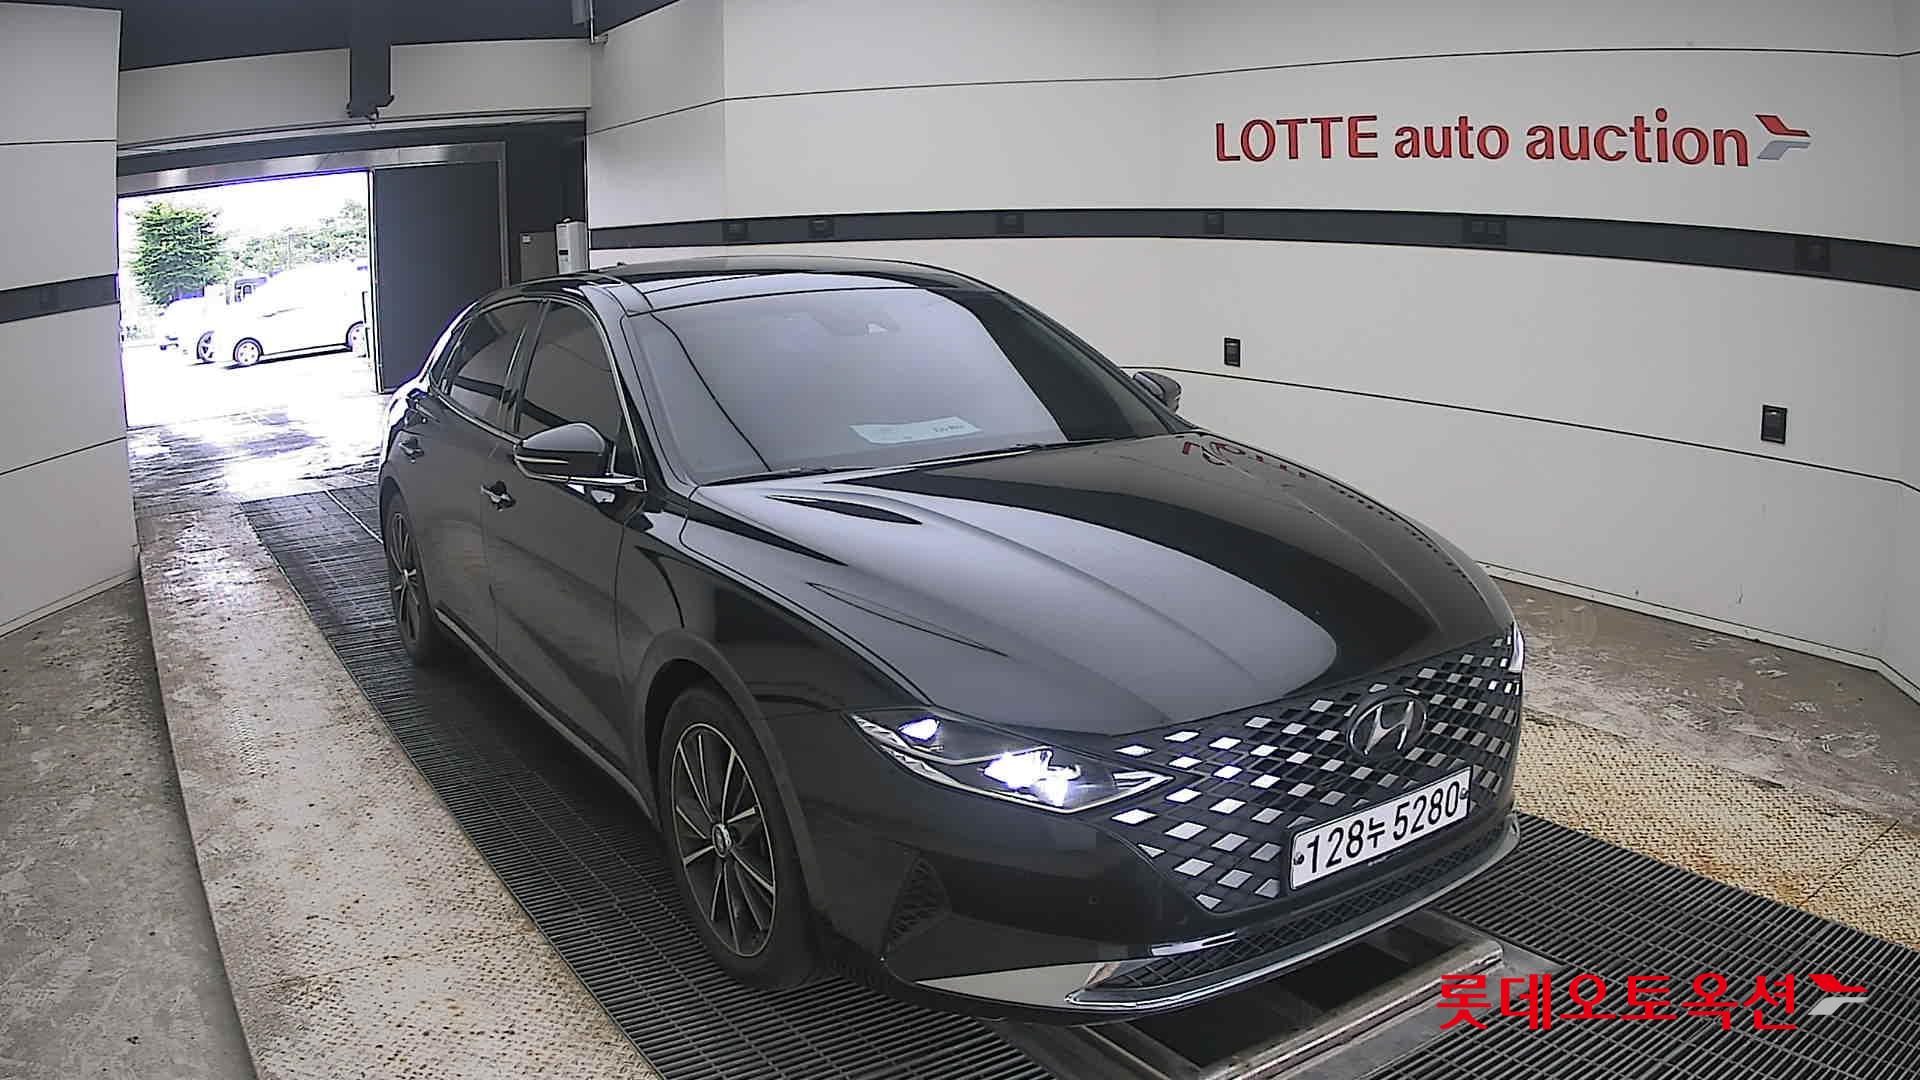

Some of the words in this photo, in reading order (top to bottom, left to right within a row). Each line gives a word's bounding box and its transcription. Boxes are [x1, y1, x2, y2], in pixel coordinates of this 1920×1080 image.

[1215, 115, 1378, 162] LOTTE
[1393, 115, 1510, 161] auto
[1525, 108, 1749, 167] auction
[1306, 817, 1385, 874] 128누
[1392, 781, 1460, 841] 5280
